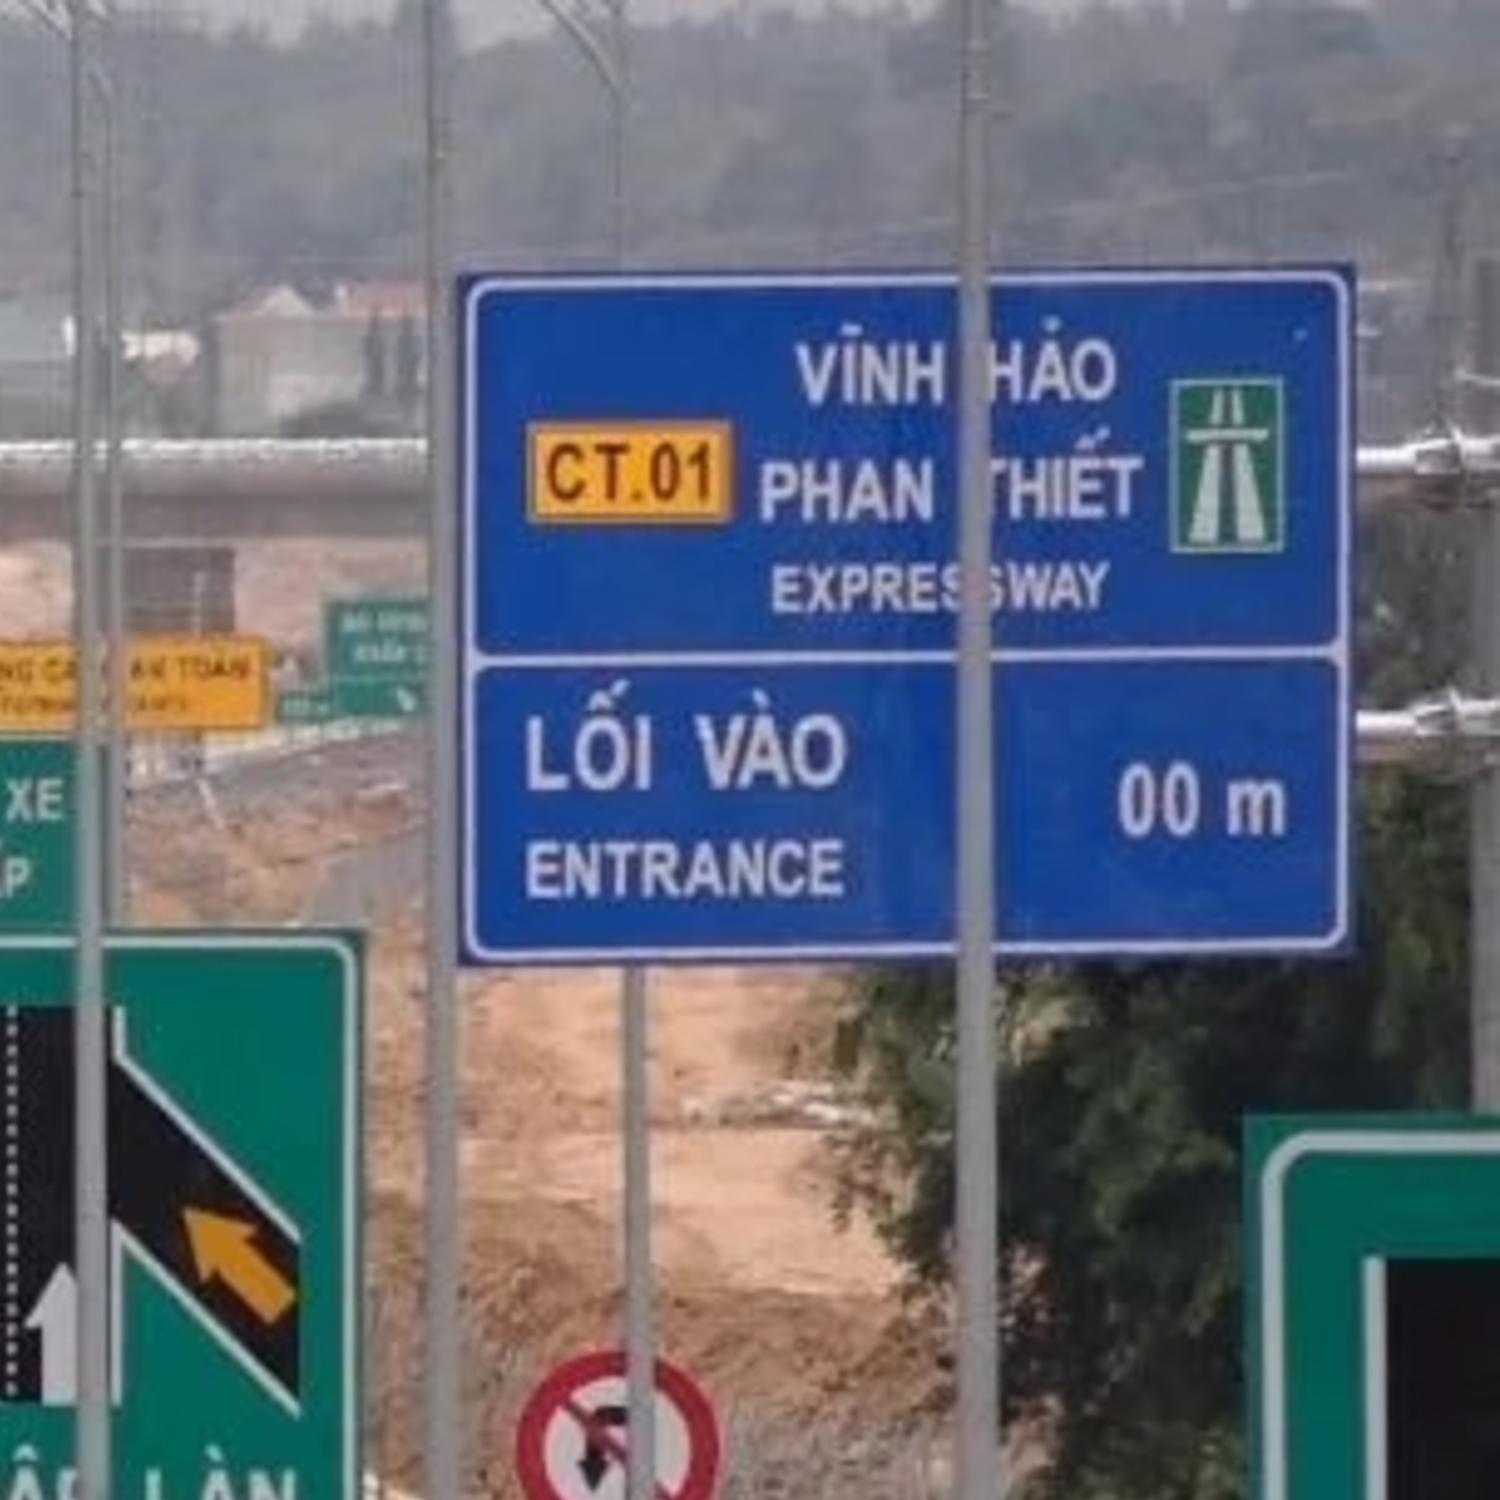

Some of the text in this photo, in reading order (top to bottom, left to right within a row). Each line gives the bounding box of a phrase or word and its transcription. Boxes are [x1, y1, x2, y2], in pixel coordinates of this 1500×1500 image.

[796, 319, 1117, 403] VĨNH HẢO
[545, 441, 713, 501] CT.01
[760, 459, 934, 522] PHAN
[526, 680, 846, 790] LỐI VÀO
[5, 777, 65, 823] XE
[1117, 762, 1286, 838] 00 m
[527, 838, 845, 899] ENTRANCE
